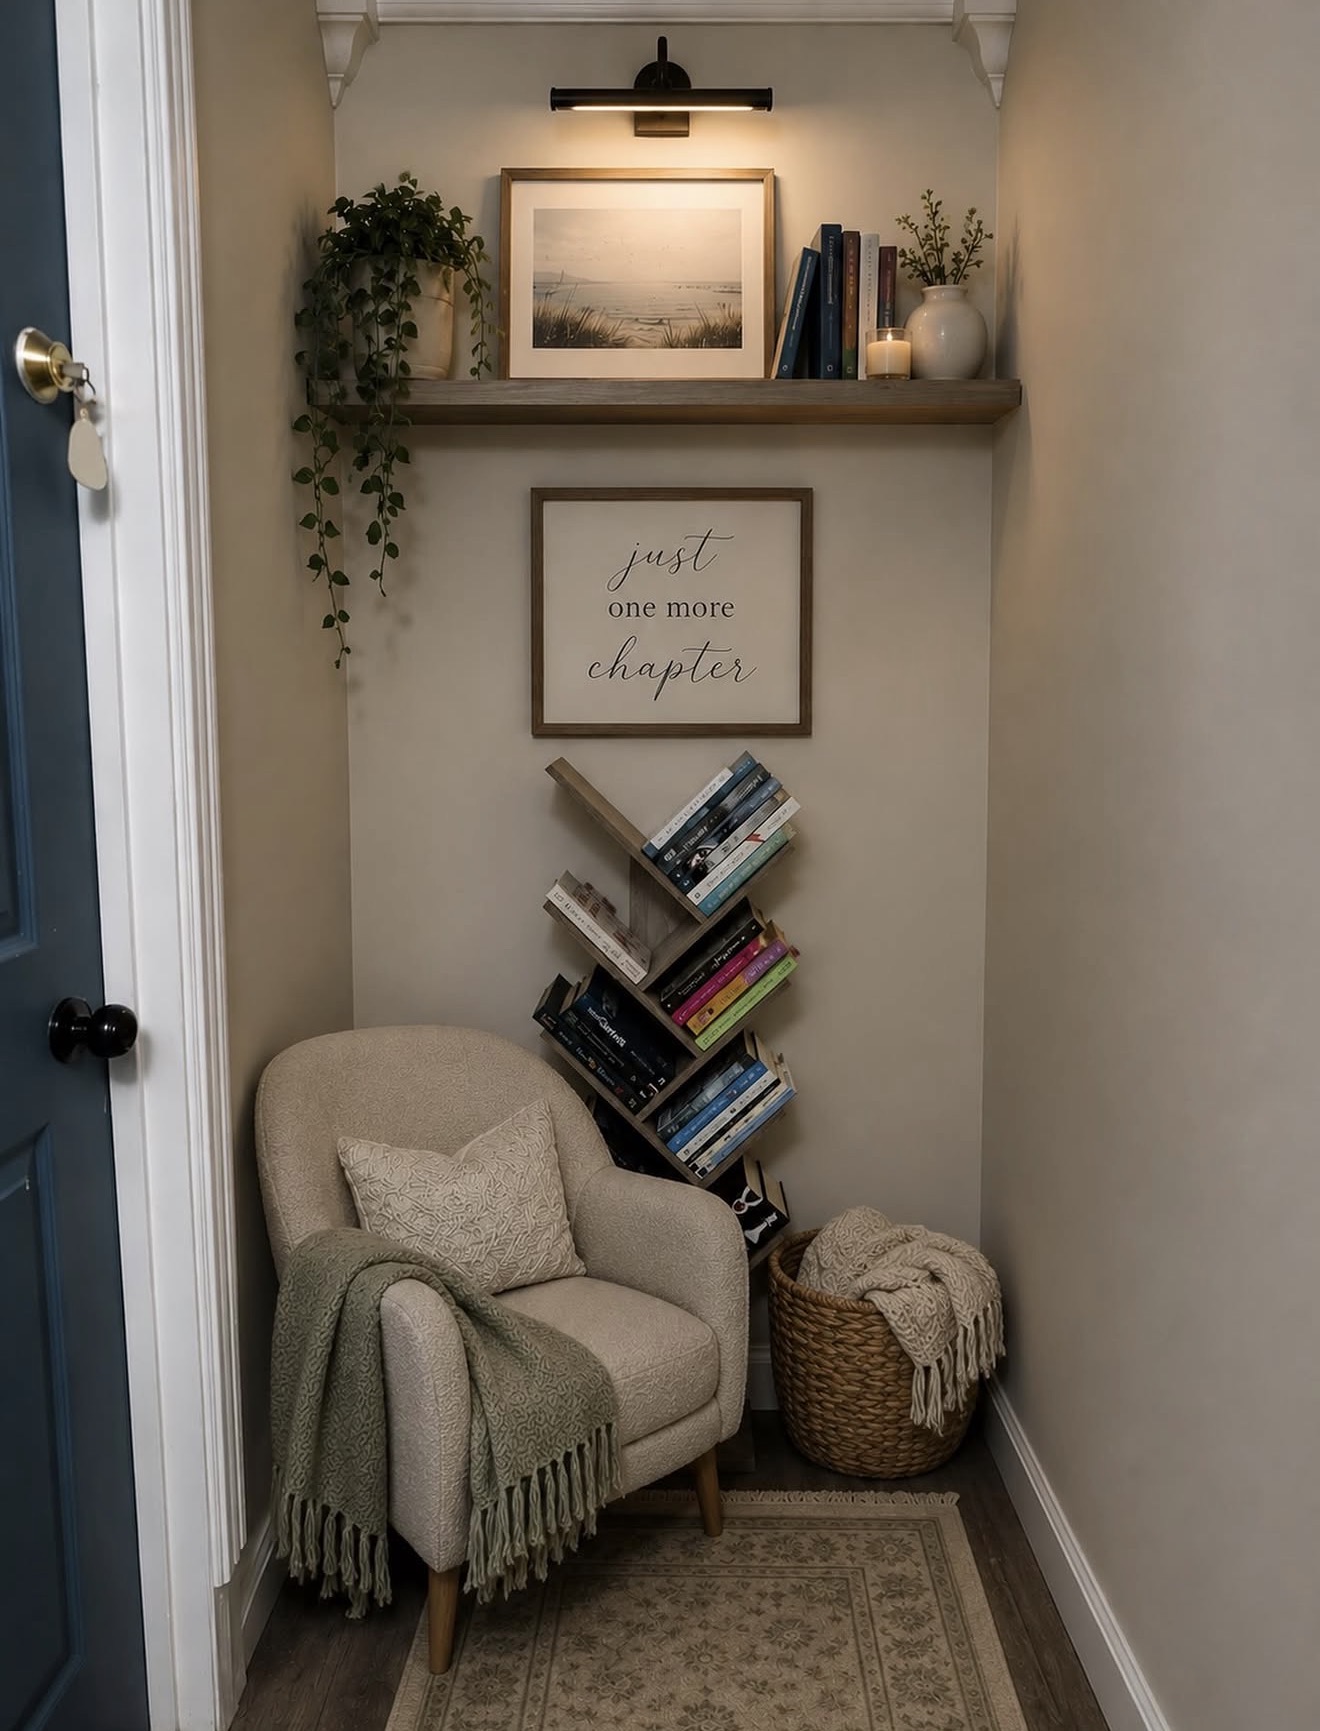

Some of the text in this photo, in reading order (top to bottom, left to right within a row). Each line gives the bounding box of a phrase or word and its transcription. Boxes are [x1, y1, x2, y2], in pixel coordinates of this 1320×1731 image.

[607, 528, 735, 592] just
[608, 601, 735, 618] one more
[588, 635, 757, 701] chapter
